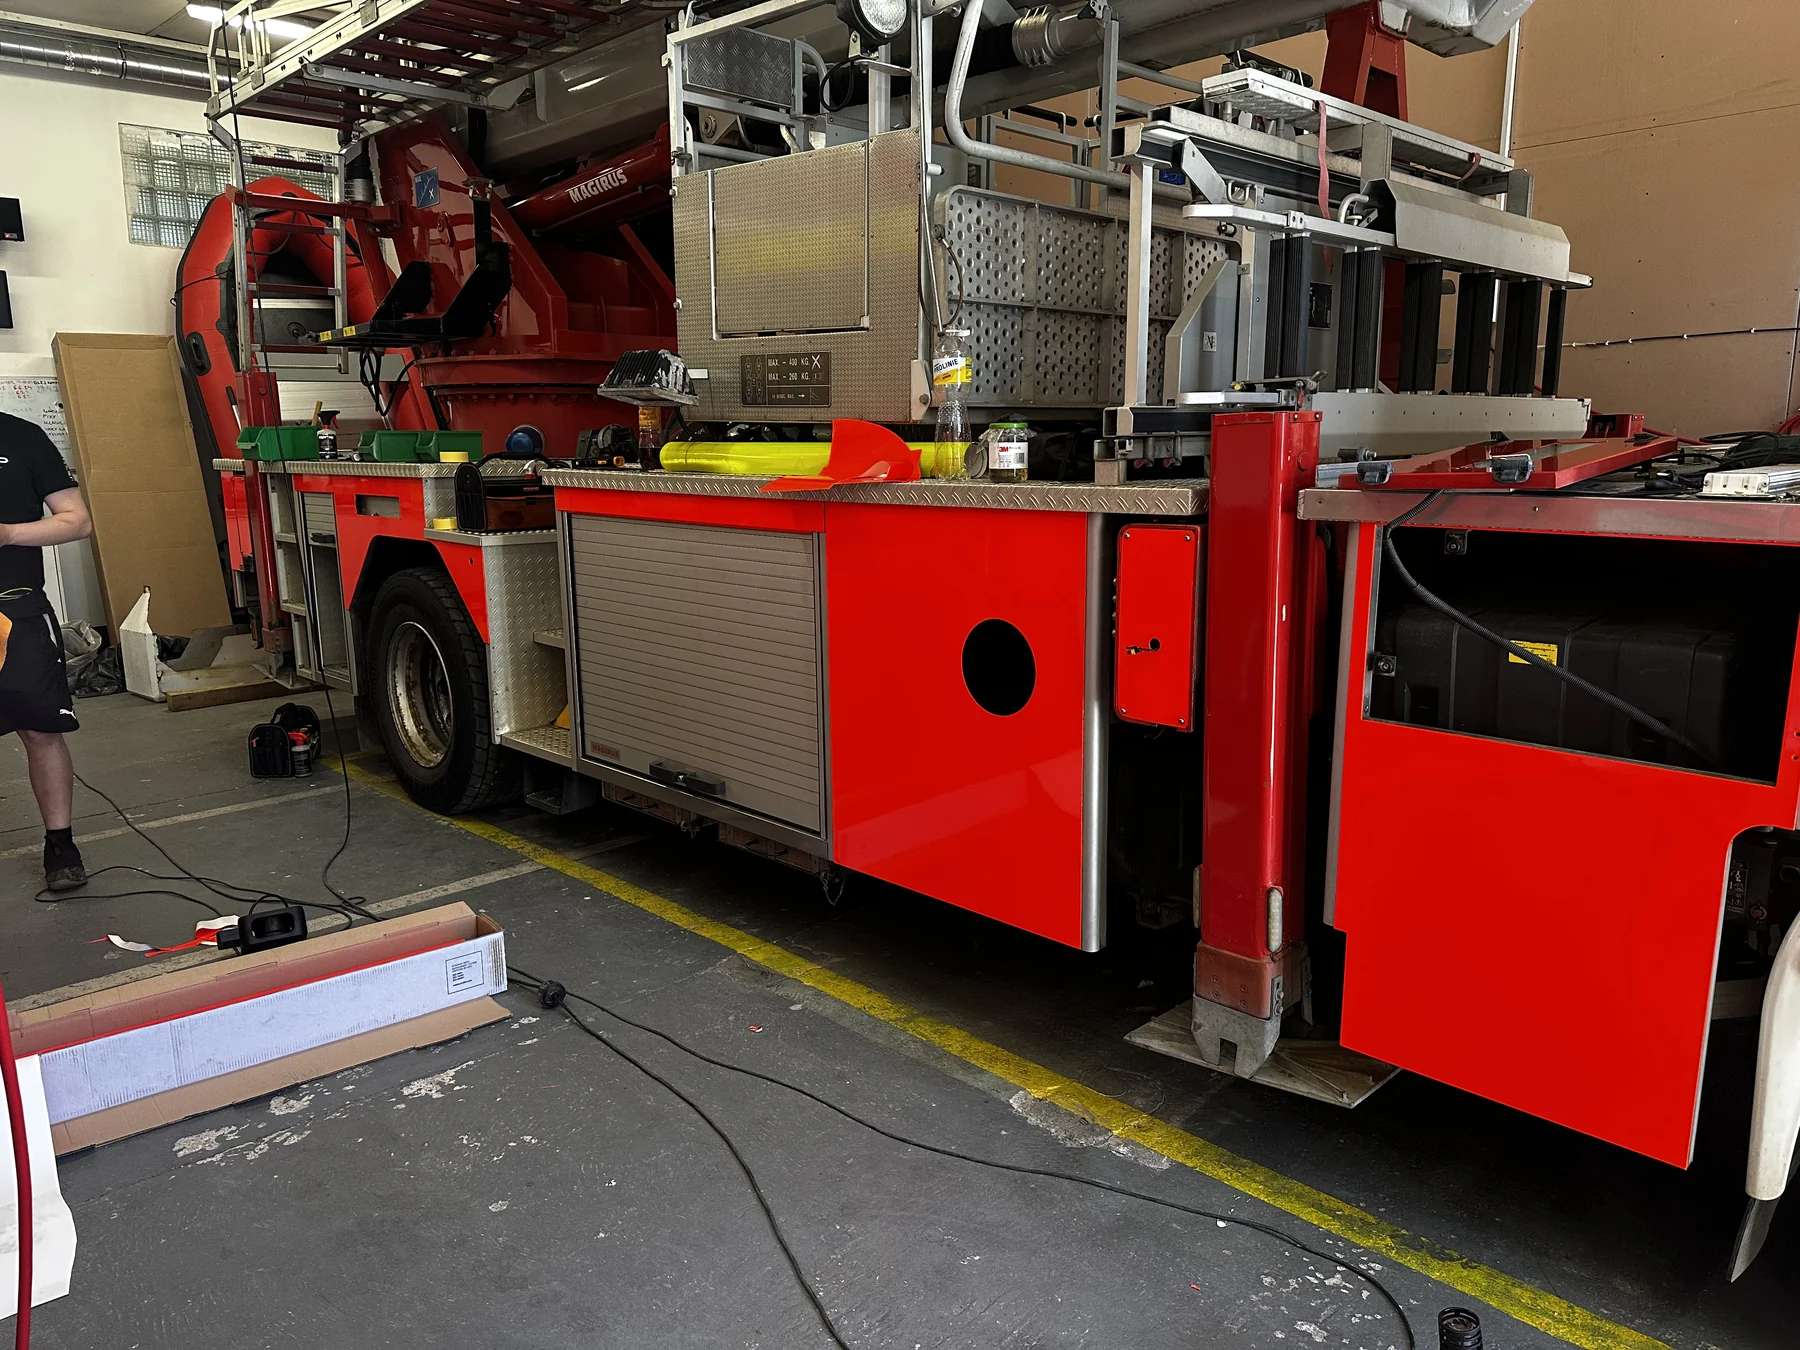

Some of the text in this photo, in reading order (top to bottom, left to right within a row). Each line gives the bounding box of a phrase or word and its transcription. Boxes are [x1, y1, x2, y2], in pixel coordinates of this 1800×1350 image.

[568, 168, 628, 204] MAGIRUS
[789, 357, 798, 366] 400
[801, 357, 810, 366] KG.
[789, 372, 798, 380] 260
[801, 372, 811, 380] KG.
[592, 743, 619, 758] MAGIRUS
